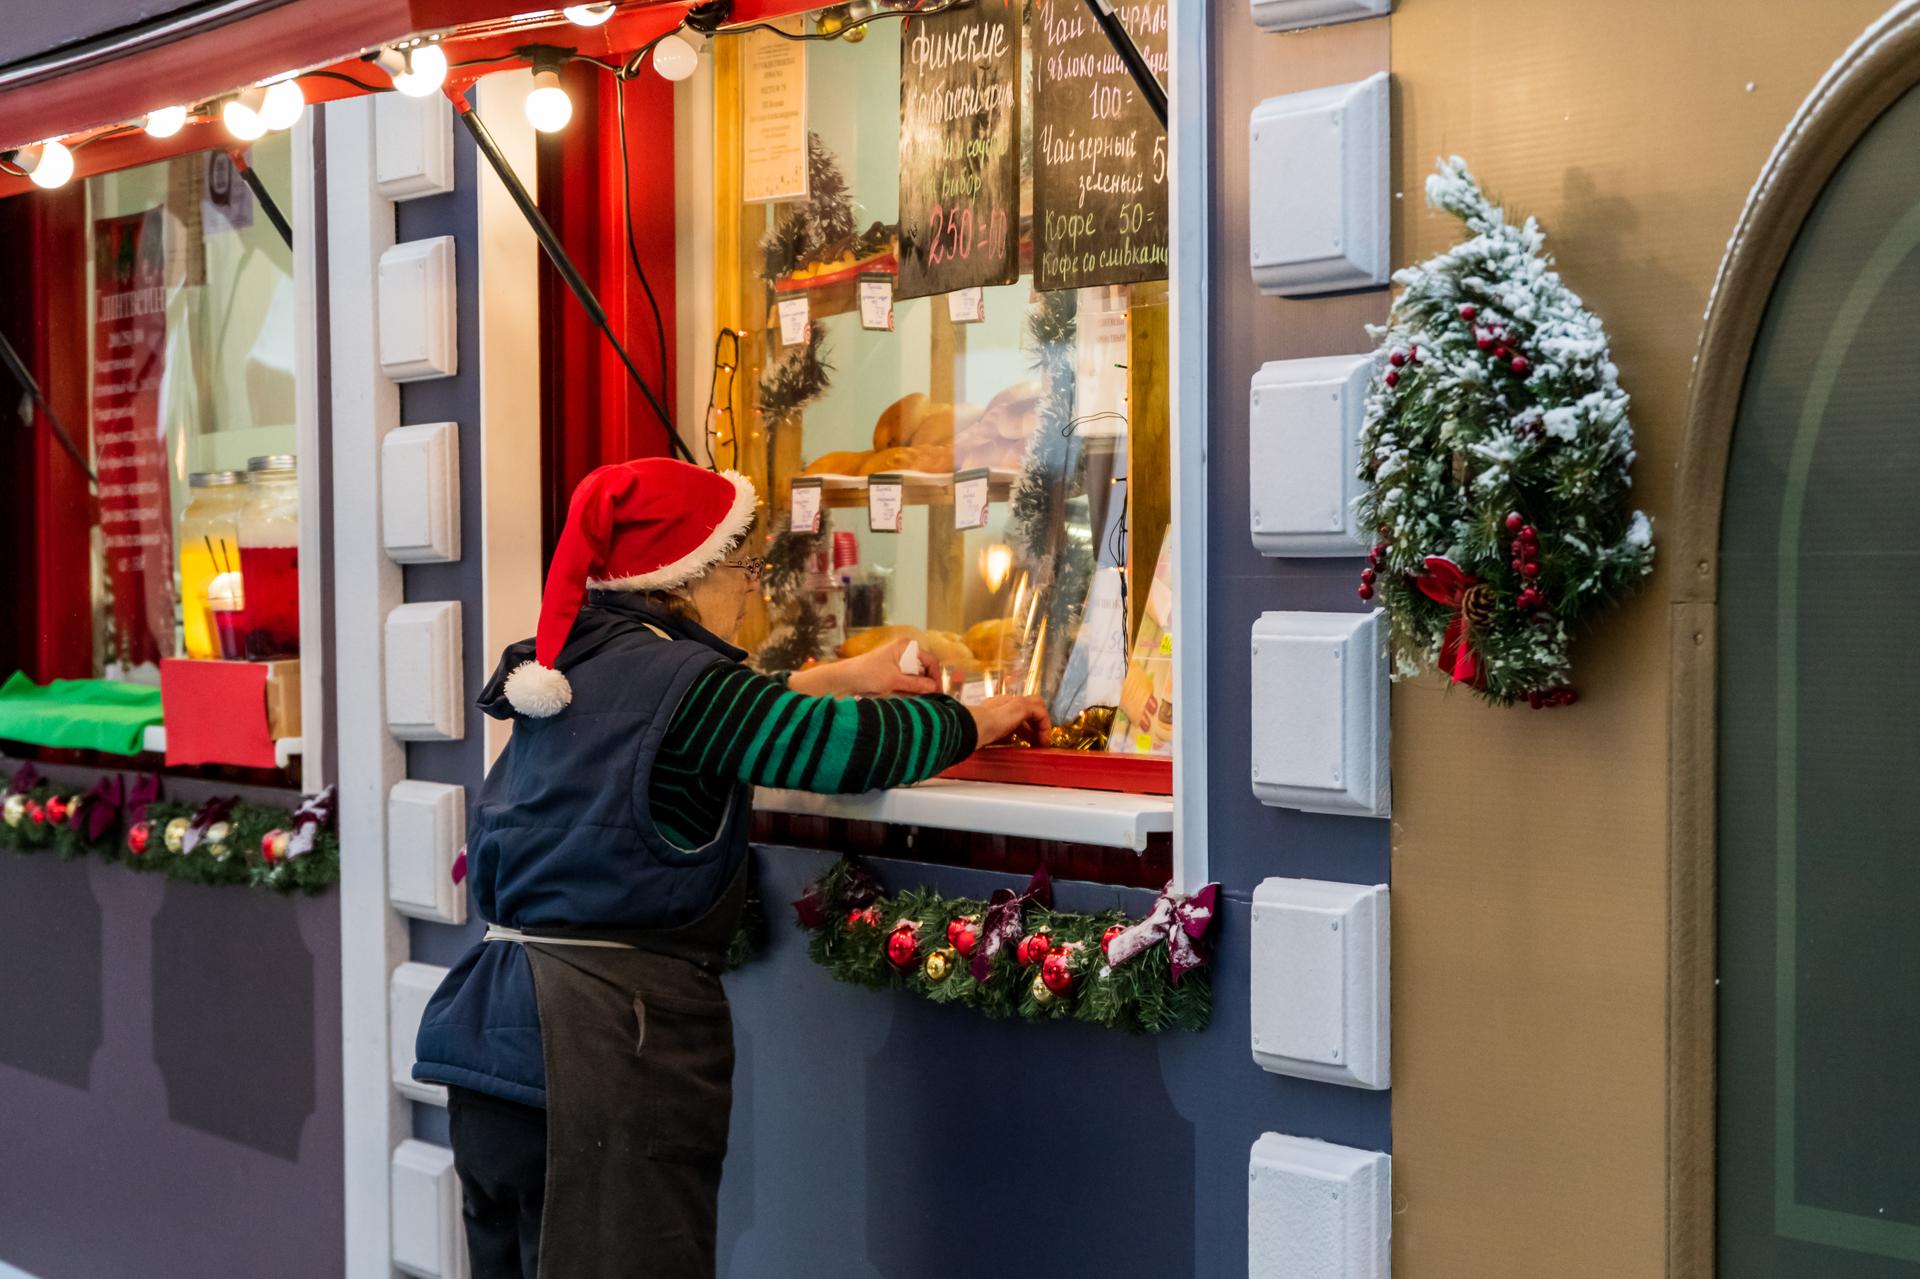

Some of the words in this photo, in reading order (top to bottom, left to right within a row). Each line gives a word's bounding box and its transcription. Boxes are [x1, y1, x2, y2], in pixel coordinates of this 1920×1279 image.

[1040, 1, 1086, 47] Чай
[1040, 124, 1075, 166] Чай
[1044, 209, 1096, 250] Кофе
[1041, 249, 1079, 283] Кофе
